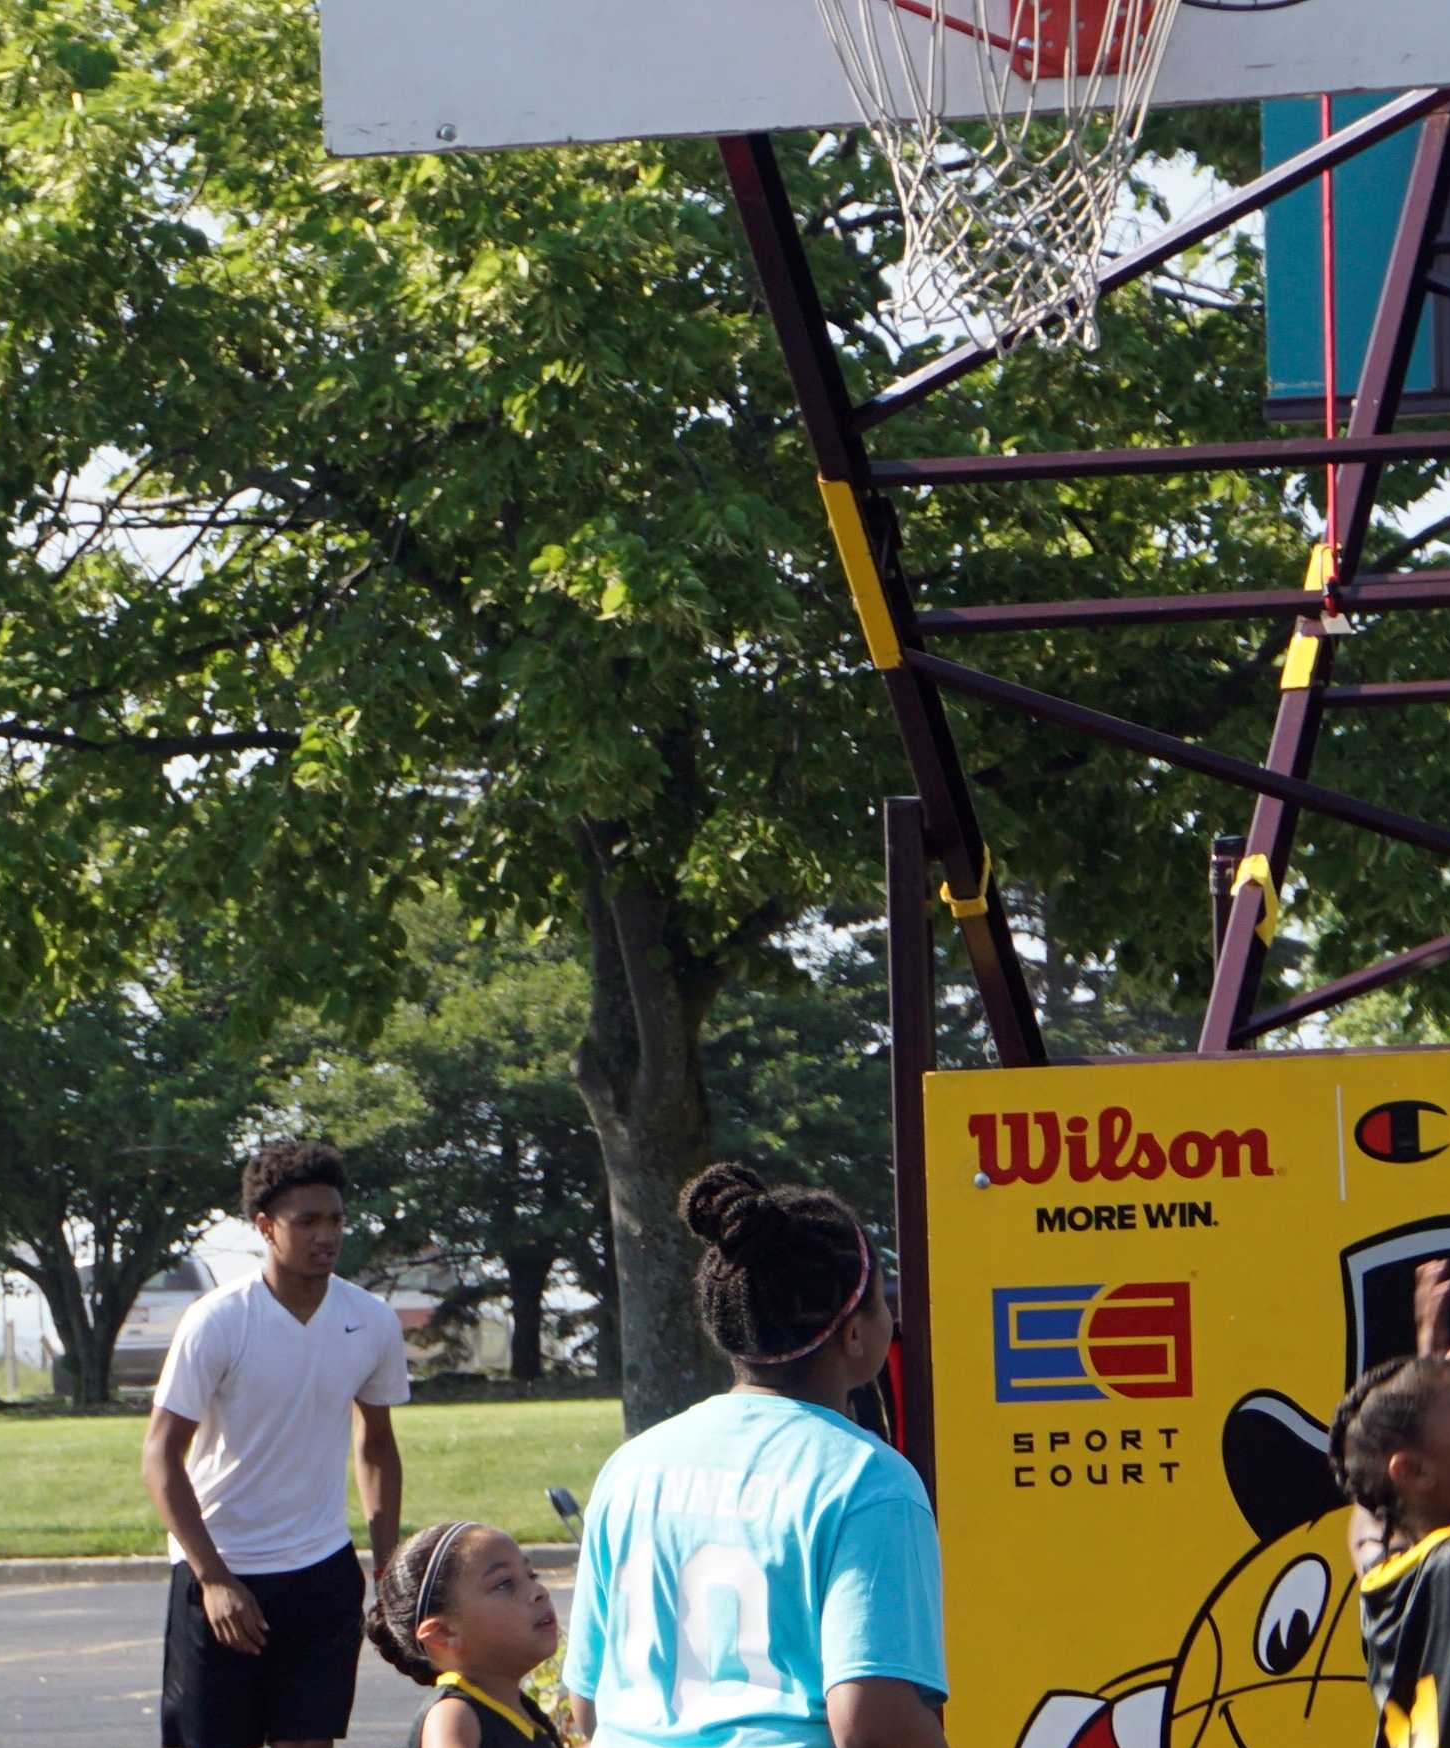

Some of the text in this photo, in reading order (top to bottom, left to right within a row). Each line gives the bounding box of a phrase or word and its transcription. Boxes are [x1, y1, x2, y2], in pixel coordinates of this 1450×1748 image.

[968, 1106, 1275, 1185] Wilson
[1036, 1200, 1219, 1233] MORE WIN.
[1013, 1428, 1180, 1454] SPORT
[1014, 1461, 1181, 1488] COURT
[603, 1540, 789, 1728] 10
